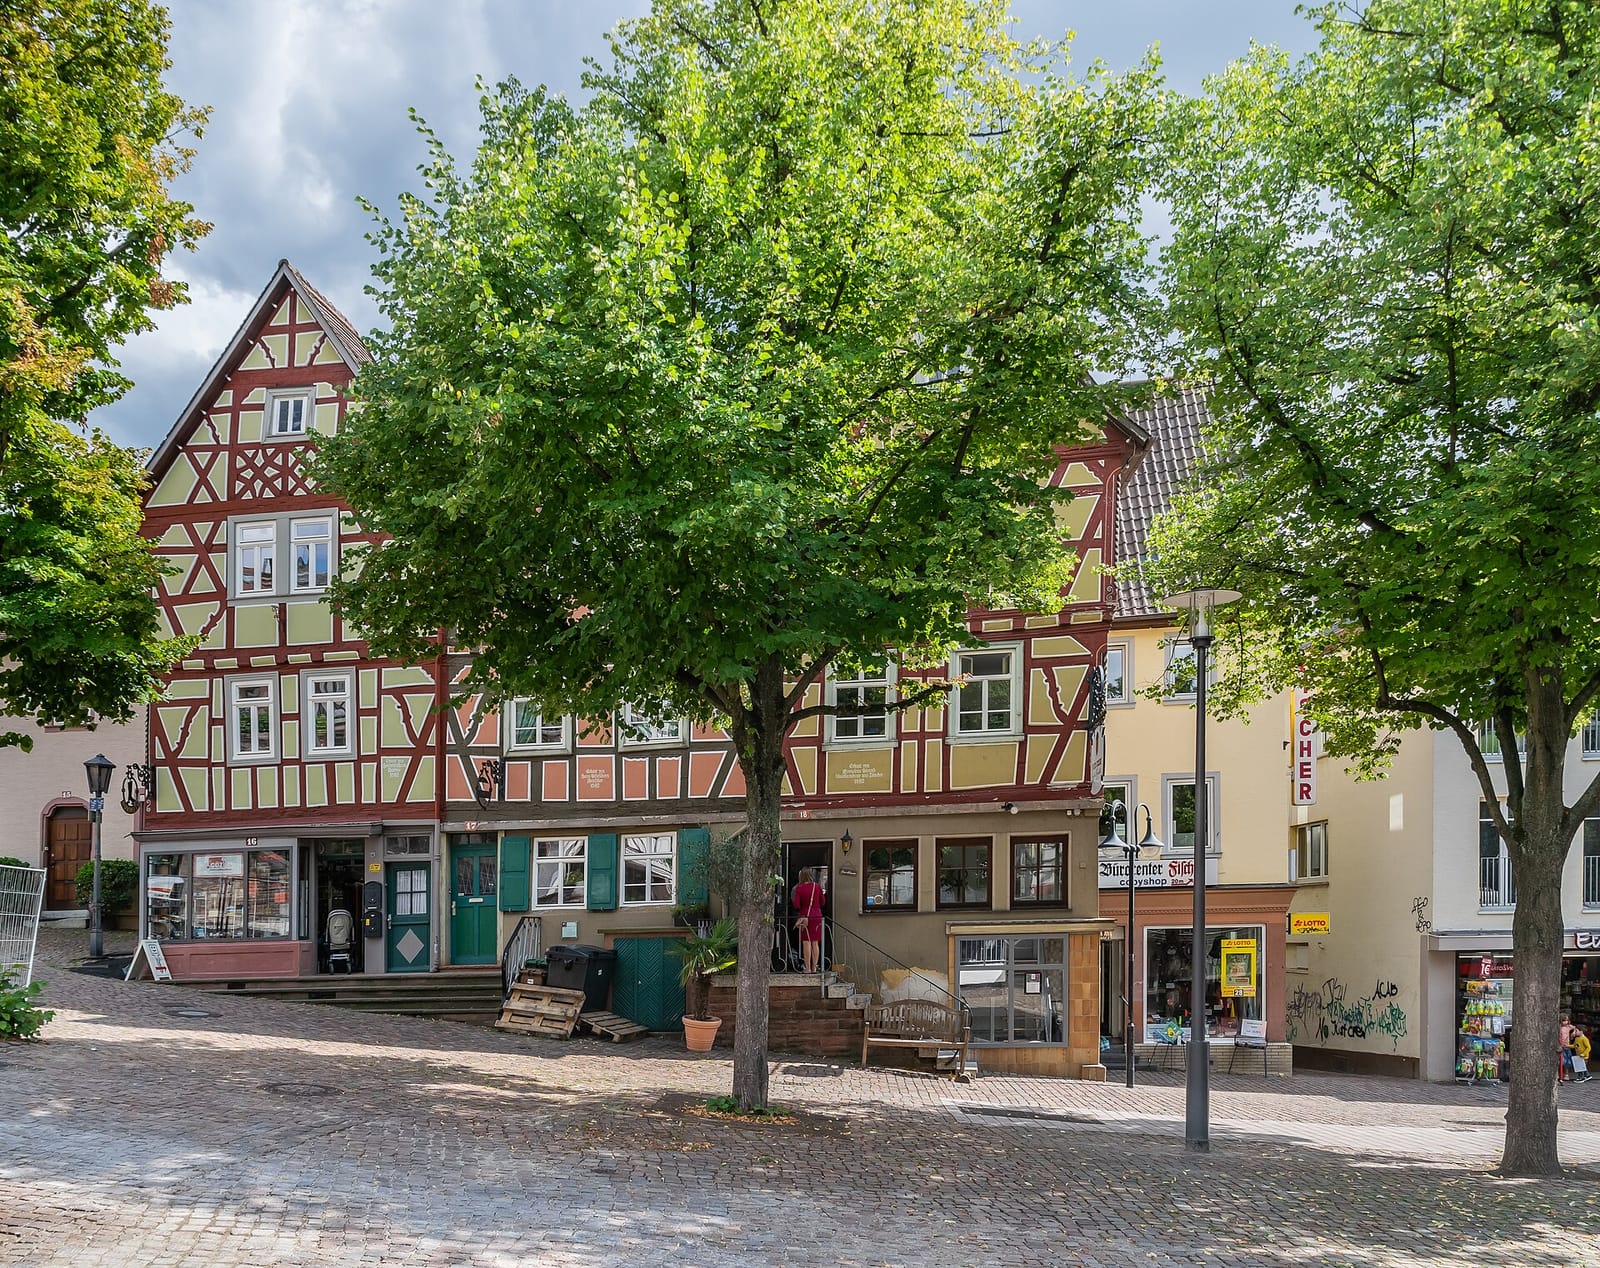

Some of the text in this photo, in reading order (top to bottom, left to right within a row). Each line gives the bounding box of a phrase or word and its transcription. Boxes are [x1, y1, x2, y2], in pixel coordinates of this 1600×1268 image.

[800, 810, 808, 818] 18
[247, 838, 257, 846] 16
[1099, 862, 1163, 877] Büroenter
